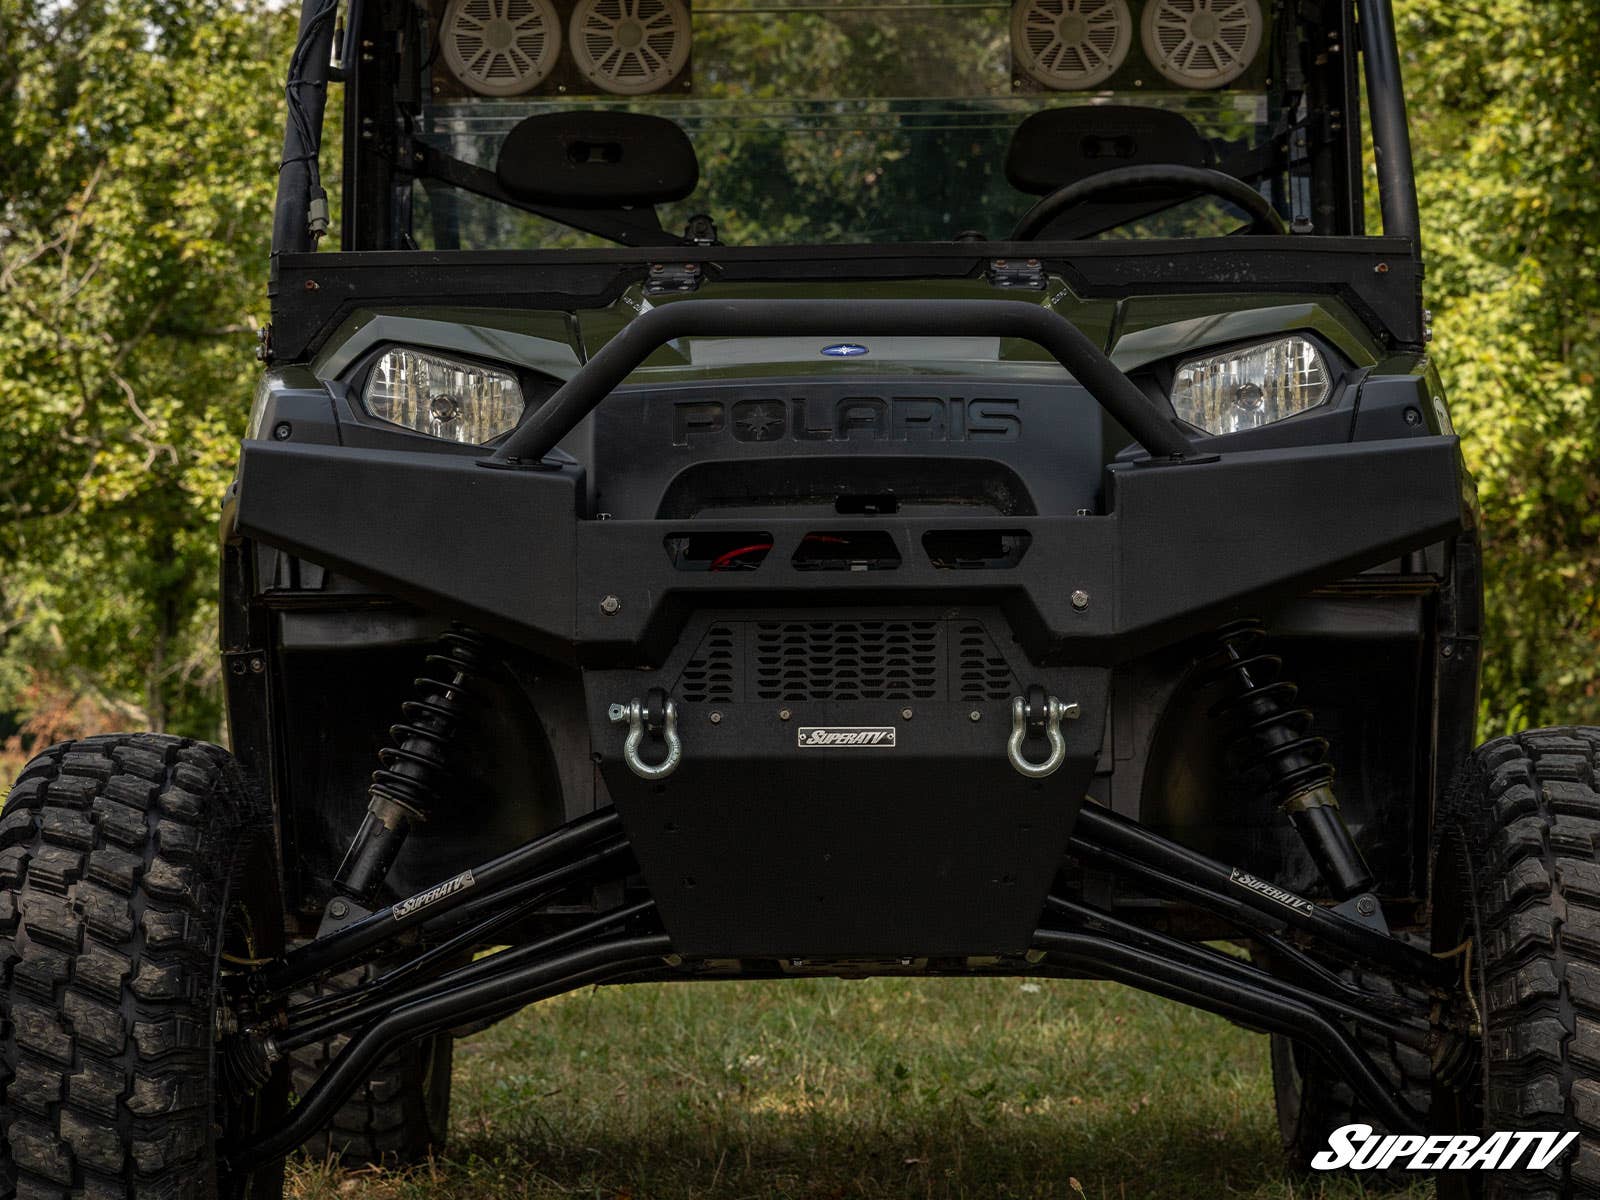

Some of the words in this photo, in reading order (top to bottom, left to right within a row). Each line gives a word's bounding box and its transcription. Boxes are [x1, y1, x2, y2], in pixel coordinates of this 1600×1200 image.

[673, 397, 1022, 447] POLARIS
[806, 730, 887, 744] SUPERATV
[400, 875, 464, 915] SUPERATV
[1238, 873, 1306, 908] SUPERATV
